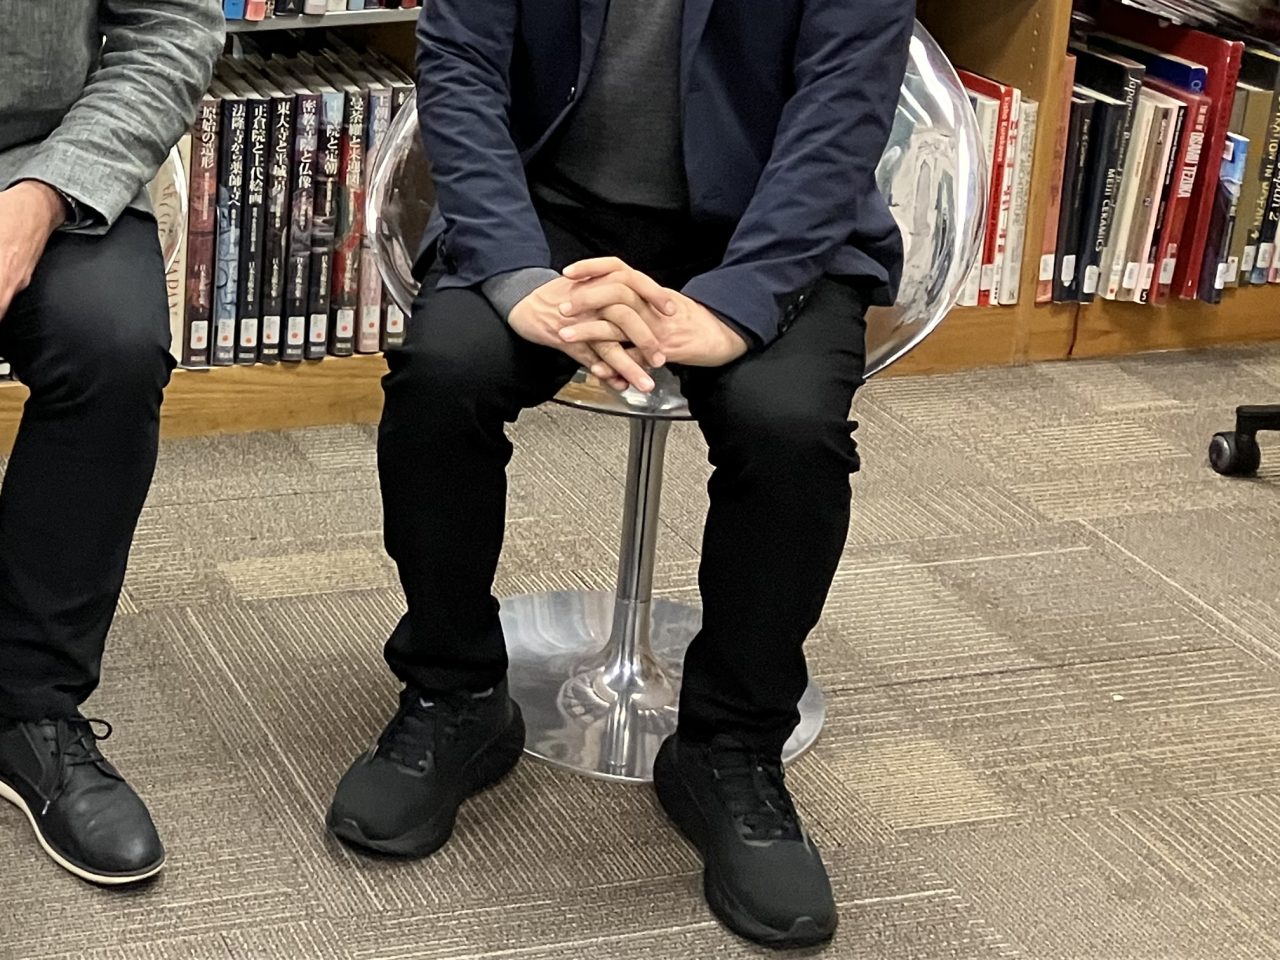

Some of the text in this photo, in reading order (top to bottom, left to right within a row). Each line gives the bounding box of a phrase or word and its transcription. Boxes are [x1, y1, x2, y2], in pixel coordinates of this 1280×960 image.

[201, 105, 216, 169] 原始の造形
[227, 103, 246, 206] 法隆寺から薬師寺へ
[248, 103, 267, 205] 正倉院と上代絵画
[272, 101, 291, 196] 東大寺と平城京
[298, 99, 317, 189] 密教寺院と仏像
[997, 121, 1008, 162] Kurokawa
[1185, 131, 1205, 164] OSAMU
[1177, 165, 1197, 198] TEZUKA
[1264, 165, 1273, 177] IN
[1095, 168, 1116, 253] MEIJI CERAMICS
[1269, 211, 1279, 222] 2
